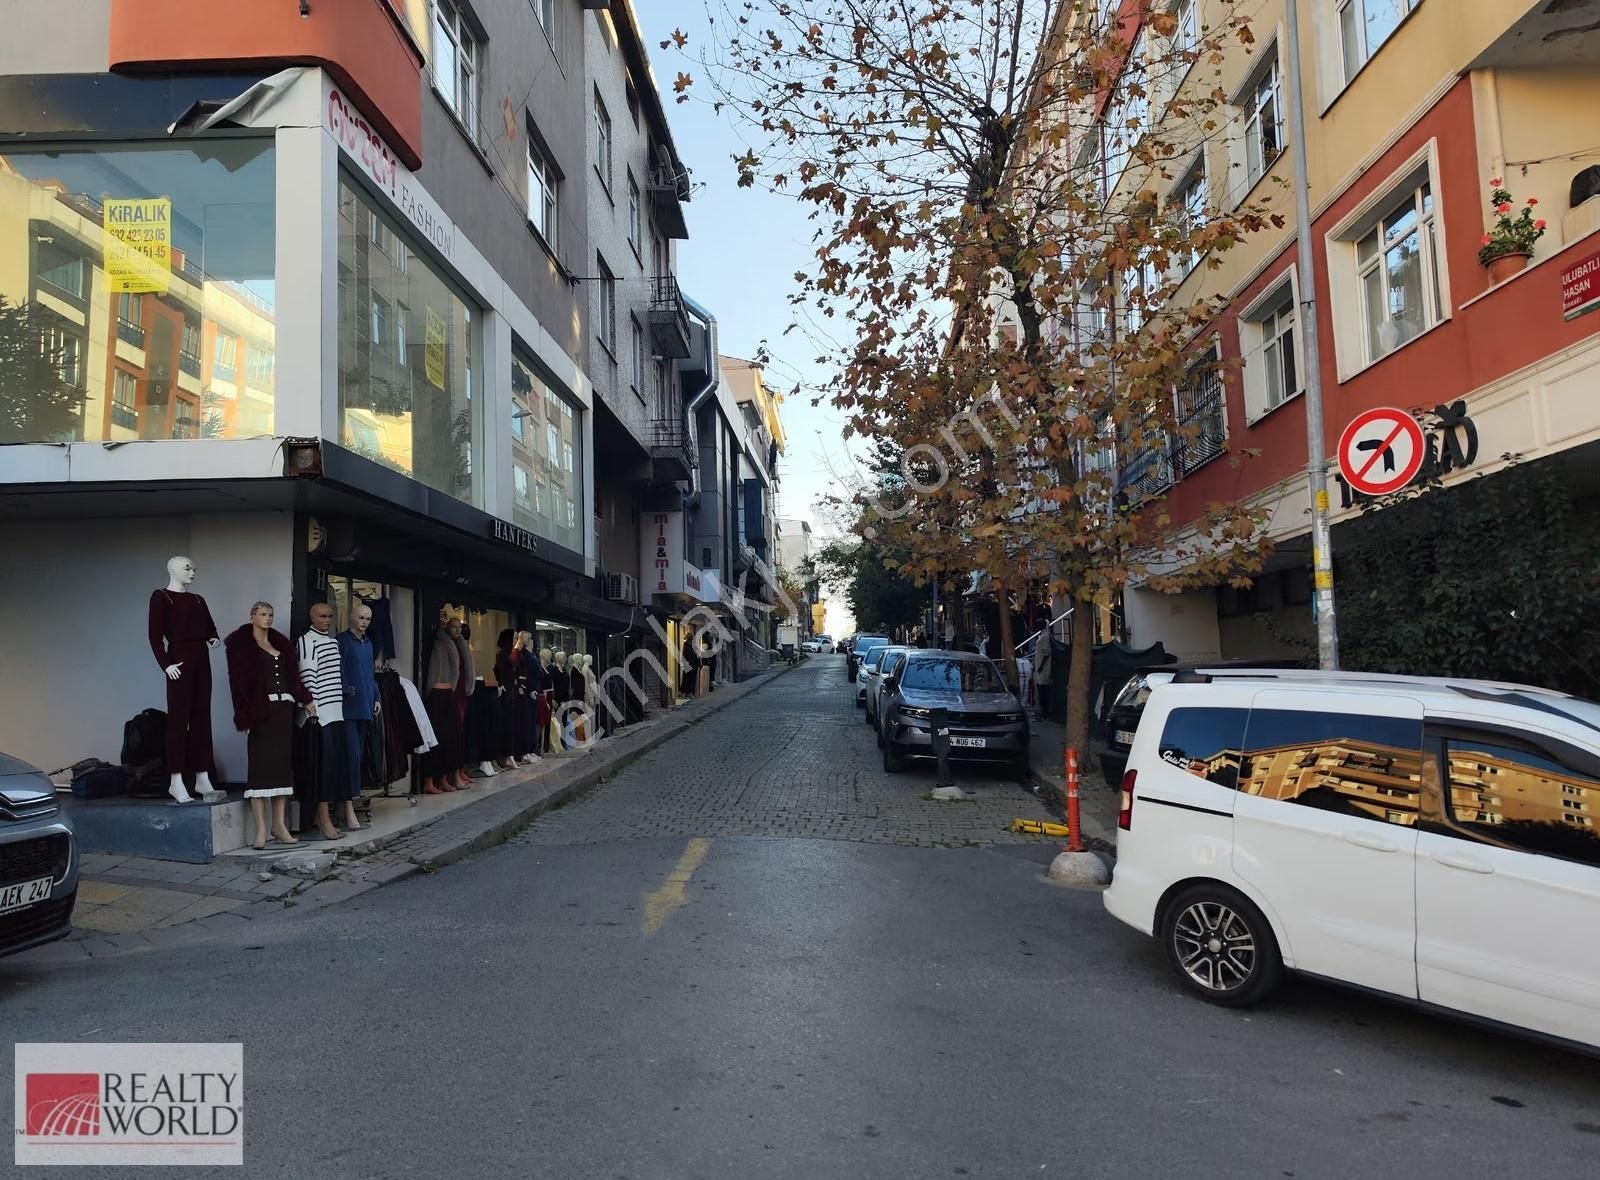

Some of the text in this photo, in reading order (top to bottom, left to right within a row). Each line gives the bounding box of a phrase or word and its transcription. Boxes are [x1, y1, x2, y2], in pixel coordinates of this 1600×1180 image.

[401, 184, 451, 256] FASHION
[143, 229, 153, 242] 23
[155, 228, 165, 241] 05
[1562, 257, 1600, 285] ULUBATLI
[1563, 279, 1590, 300] HASAN
[494, 519, 538, 553] HANTEKS
[0, 879, 51, 909] AEK 247
